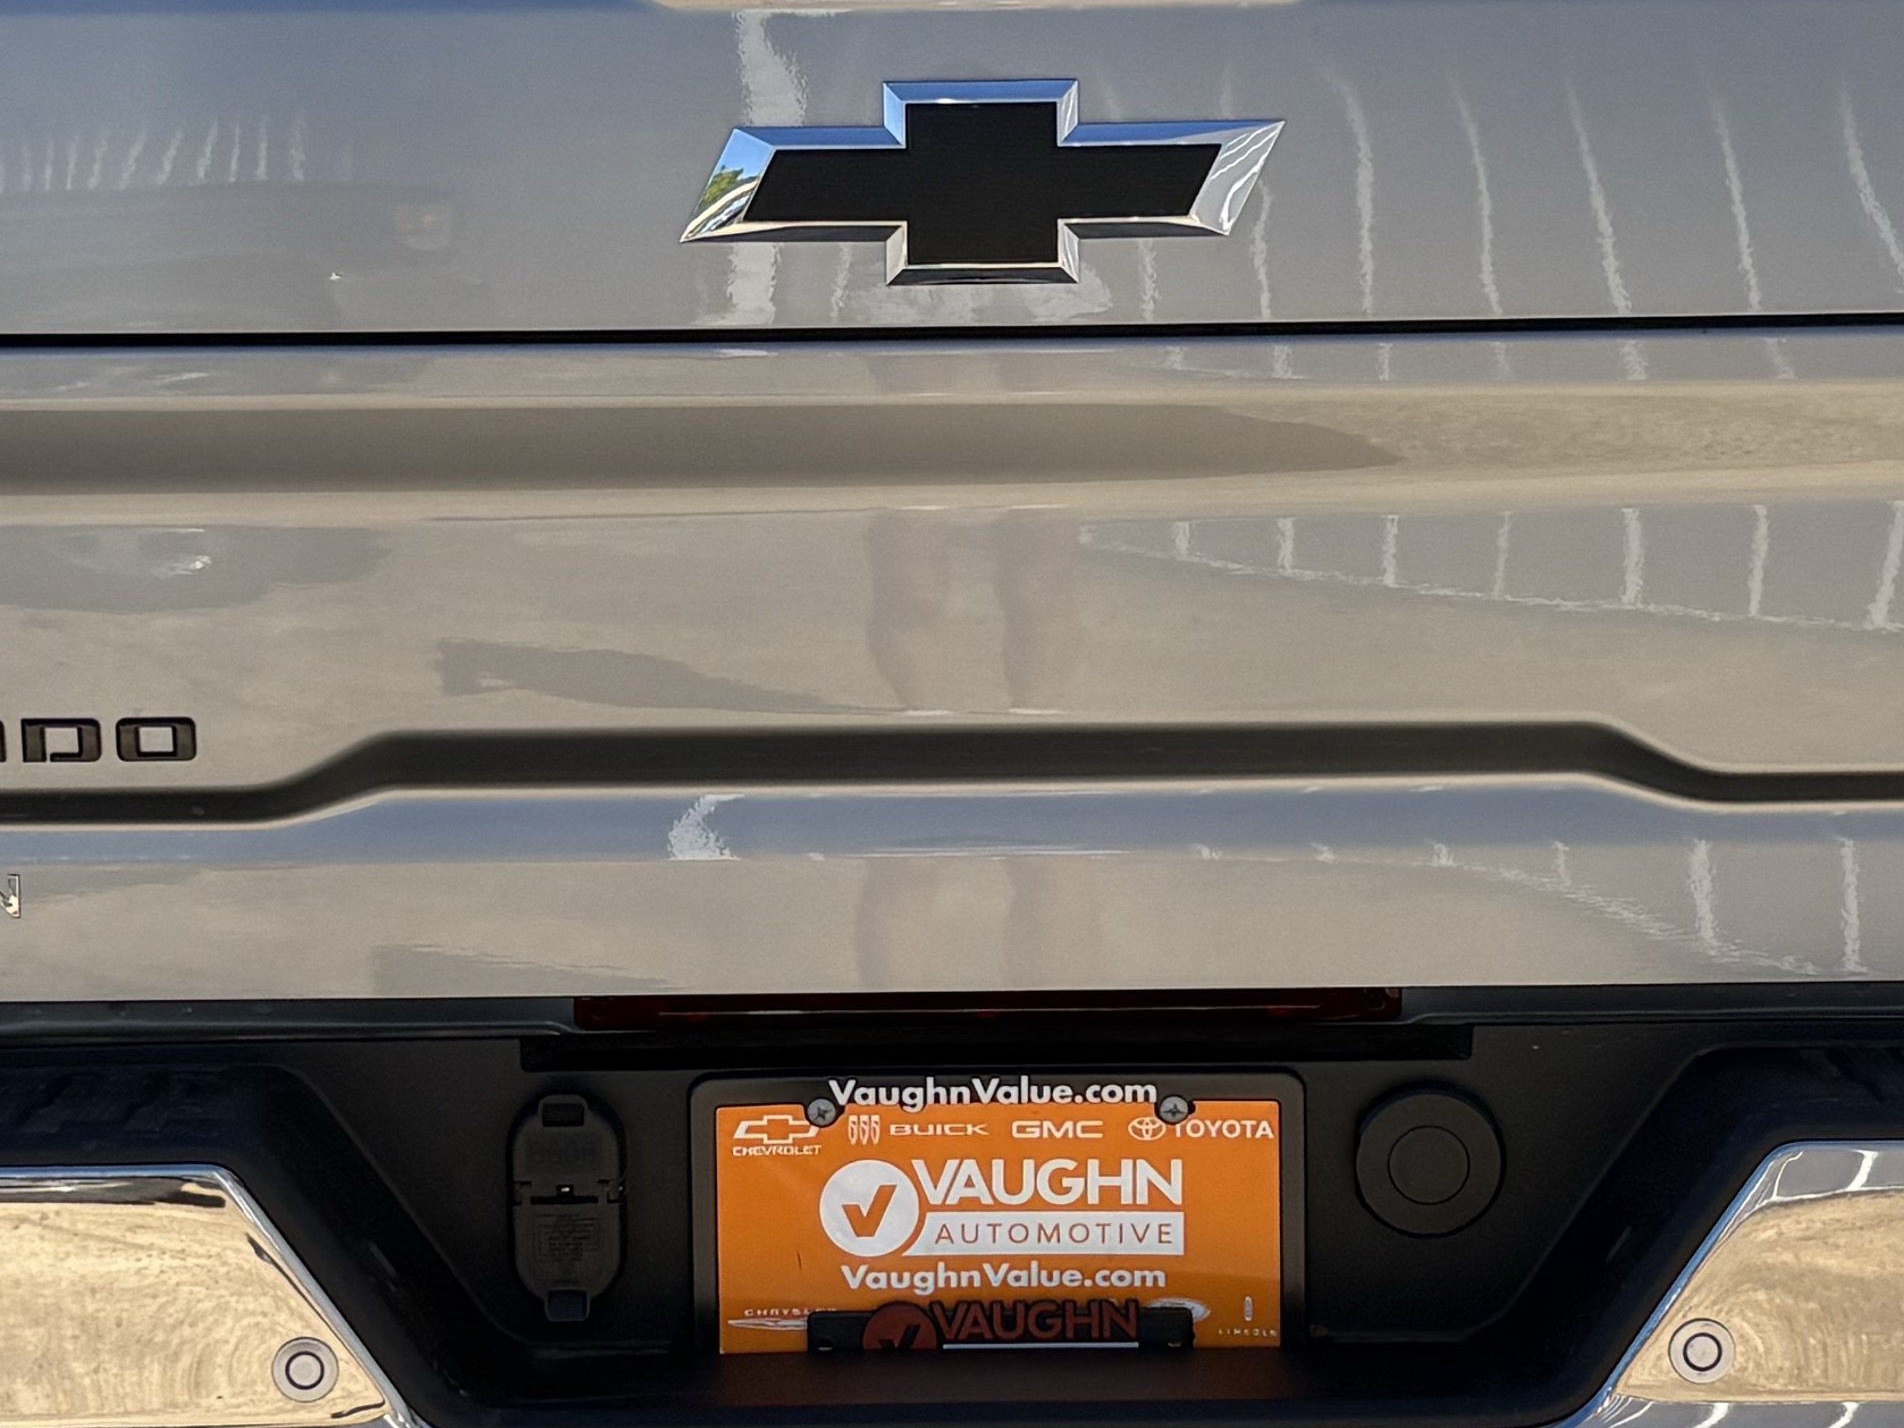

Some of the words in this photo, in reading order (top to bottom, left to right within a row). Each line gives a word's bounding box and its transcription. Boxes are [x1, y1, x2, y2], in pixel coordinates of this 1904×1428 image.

[828, 1075, 1157, 1113] VaughnValue.com
[889, 1123, 990, 1136] BUICK
[1011, 1120, 1104, 1139] GMC
[1172, 1119, 1275, 1139] TOYOTA
[732, 1144, 823, 1157] CHEVROLET
[911, 1158, 1183, 1205] VAUGHN
[934, 1222, 1173, 1245] AUTOMOTIVE
[840, 1260, 1167, 1296] VaughnValue.com
[929, 1301, 1139, 1340] VAUGHN
